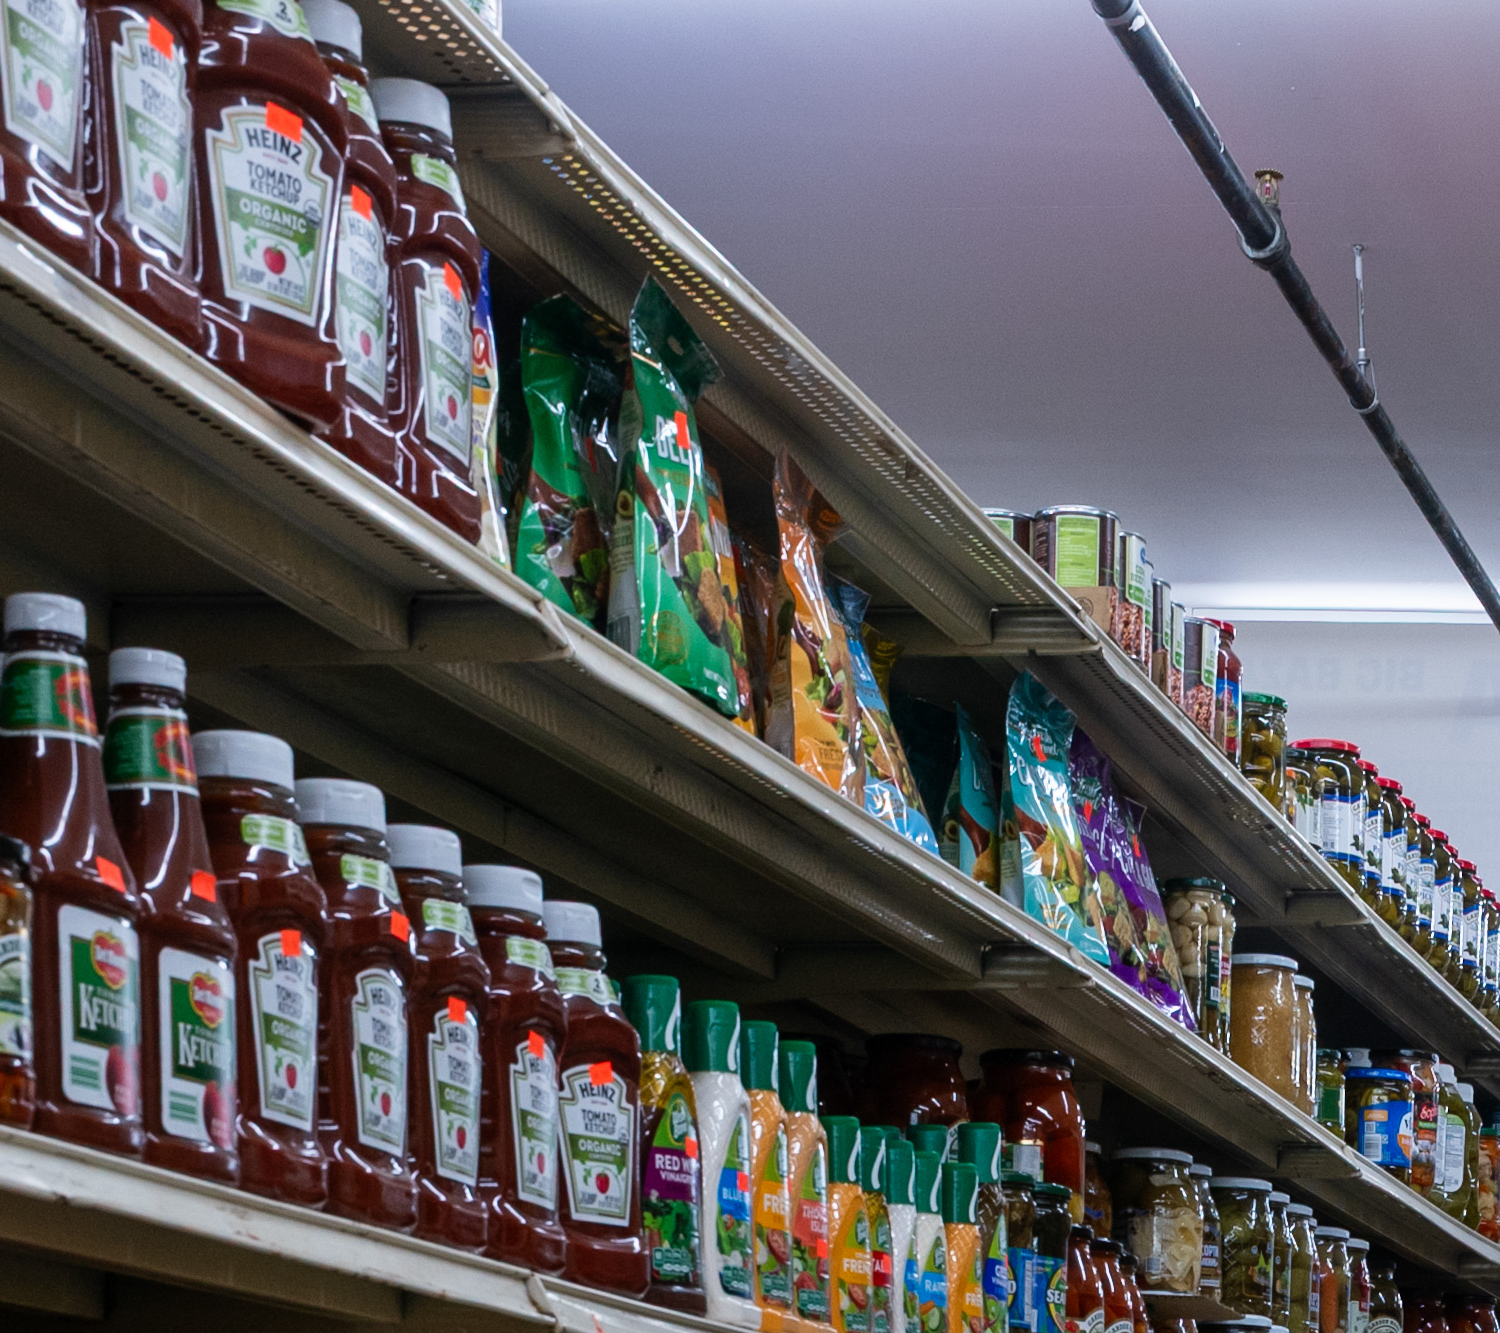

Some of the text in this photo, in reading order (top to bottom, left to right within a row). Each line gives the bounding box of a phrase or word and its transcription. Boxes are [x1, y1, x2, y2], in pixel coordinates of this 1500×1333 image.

[246, 128, 304, 165] HEINZ
[247, 160, 302, 193] TOMATO
[250, 180, 301, 206] KETCHUP
[240, 198, 308, 235] ORGANIC
[347, 216, 378, 252] HEINZ
[578, 1081, 616, 1103] HEINZ
[581, 1108, 617, 1124] TOMATO
[584, 1122, 616, 1135] KETCHUP
[578, 1140, 621, 1157] ORGANIC
[654, 1153, 680, 1171] RED
